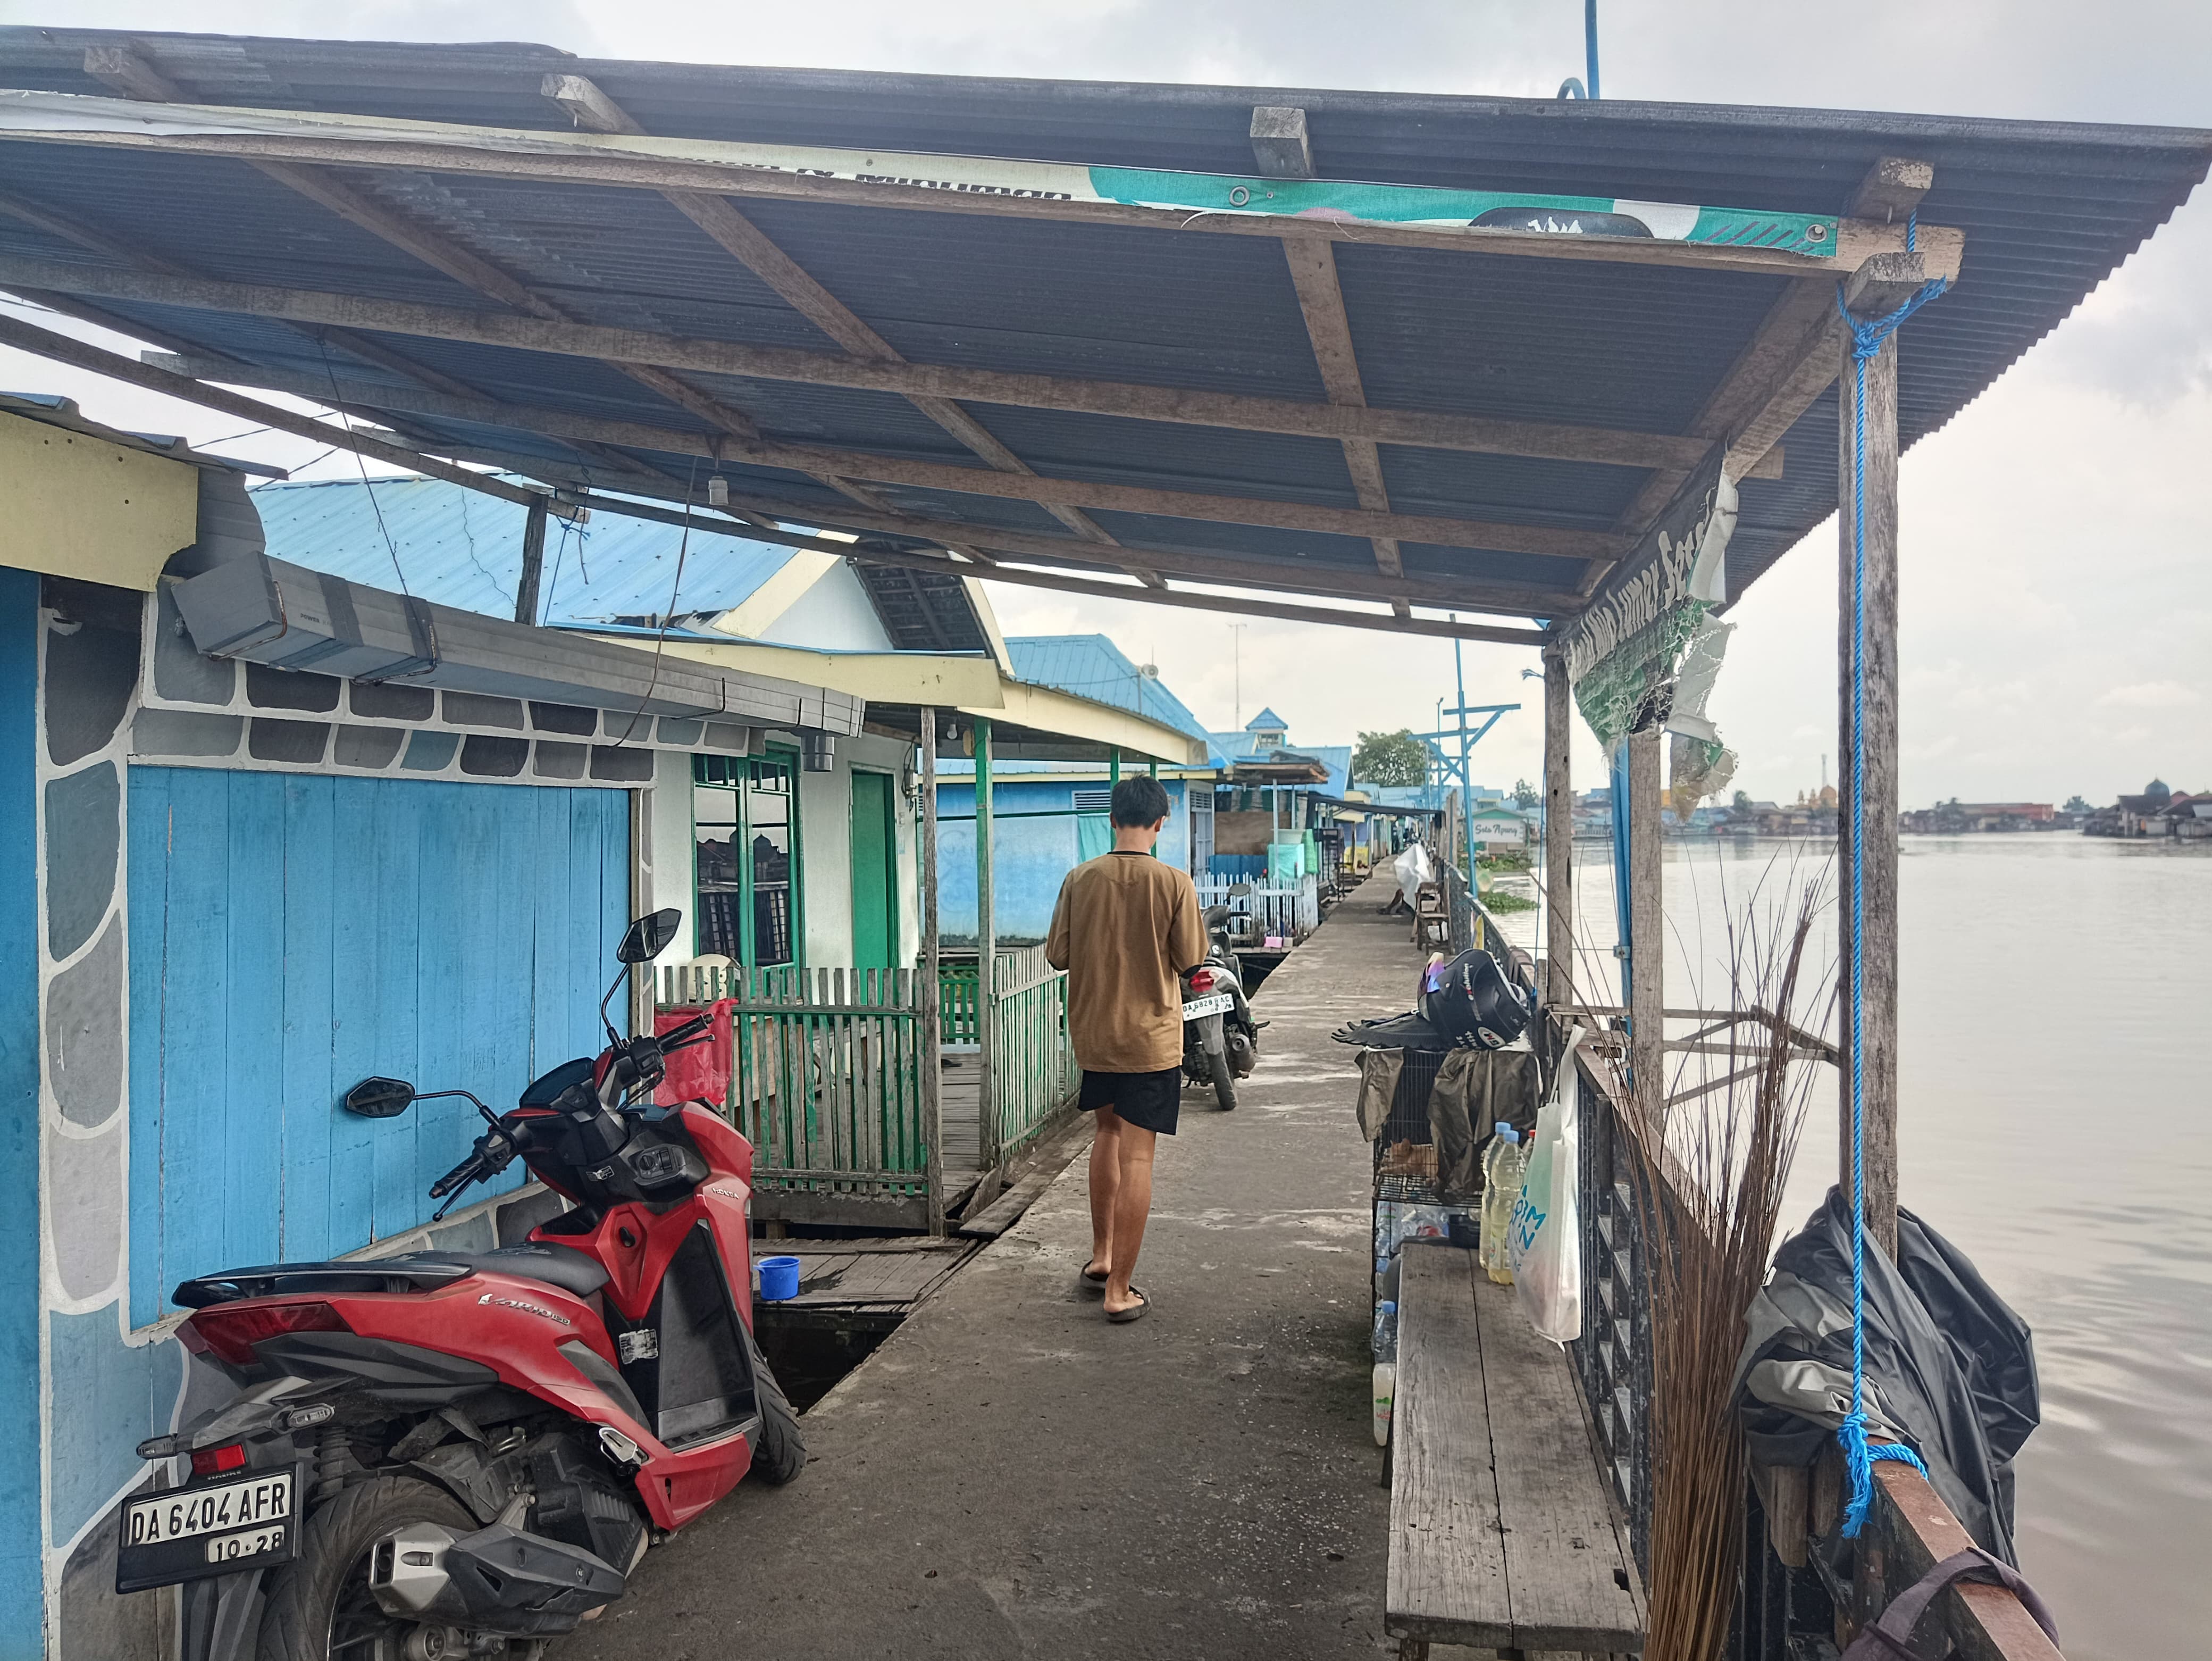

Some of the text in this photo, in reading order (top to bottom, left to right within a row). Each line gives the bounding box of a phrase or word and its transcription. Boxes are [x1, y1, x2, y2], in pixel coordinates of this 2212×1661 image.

[300, 613, 320, 623] POWER
[1493, 824, 1518, 837] Apung
[1484, 1031, 1499, 1047] GM
[711, 1187, 740, 1200] HONDA
[477, 1293, 553, 1318] VARIO
[131, 1482, 286, 1545] DA 6404 AFR
